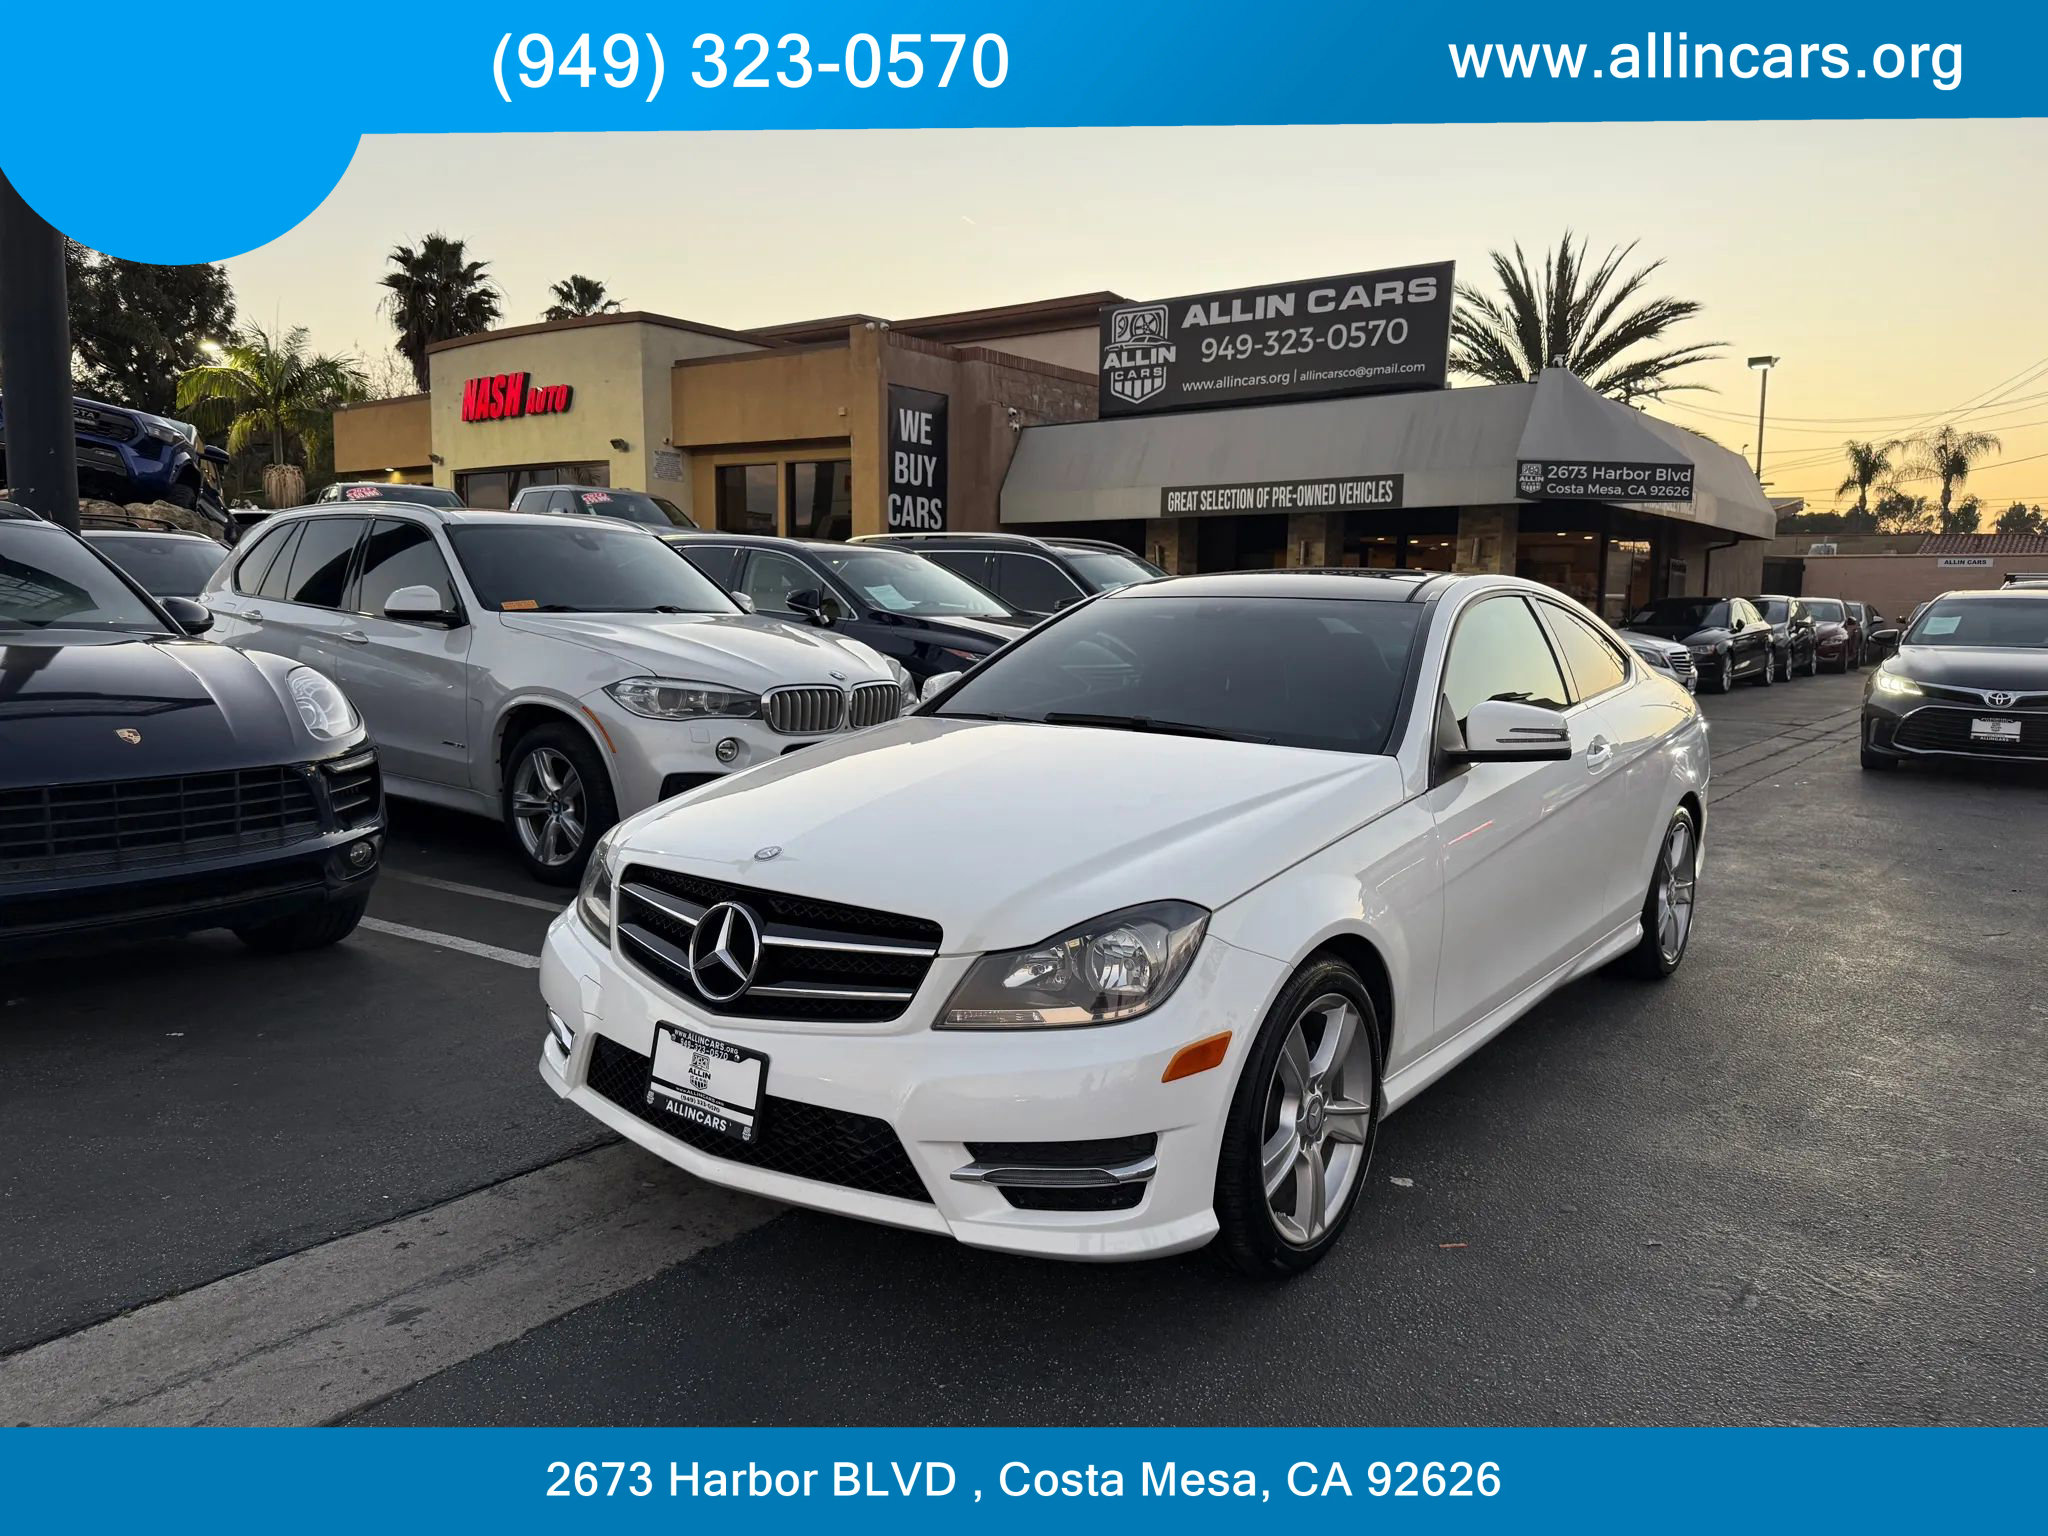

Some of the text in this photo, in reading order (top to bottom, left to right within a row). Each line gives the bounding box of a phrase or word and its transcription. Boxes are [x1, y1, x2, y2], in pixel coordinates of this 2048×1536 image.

[1181, 277, 1437, 328] ALLIN CARS
[1201, 318, 1409, 363] 949-323-0570
[1103, 346, 1176, 369] ALLIN
[1114, 367, 1162, 380] CARS
[1182, 362, 1425, 392] www.allincars.org allincarsco@gmail.com
[462, 372, 526, 422] NASH
[899, 408, 933, 446] WE
[894, 451, 937, 488] BUY
[1547, 466, 1691, 482] 2673 Harbor Blvd
[1168, 480, 1394, 512] GREAT SELECTION OF PRE-OWNED VEHICLES
[1547, 483, 1584, 494] Costa
[1588, 484, 1625, 496] Mesa,
[1627, 485, 1647, 496] CA
[1650, 485, 1690, 497] 92626
[888, 493, 943, 530] CARS
[680, 1038, 729, 1061] 949-323-0570
[688, 1067, 711, 1081] ALLIN
[666, 1100, 727, 1132] ALLINCARS
